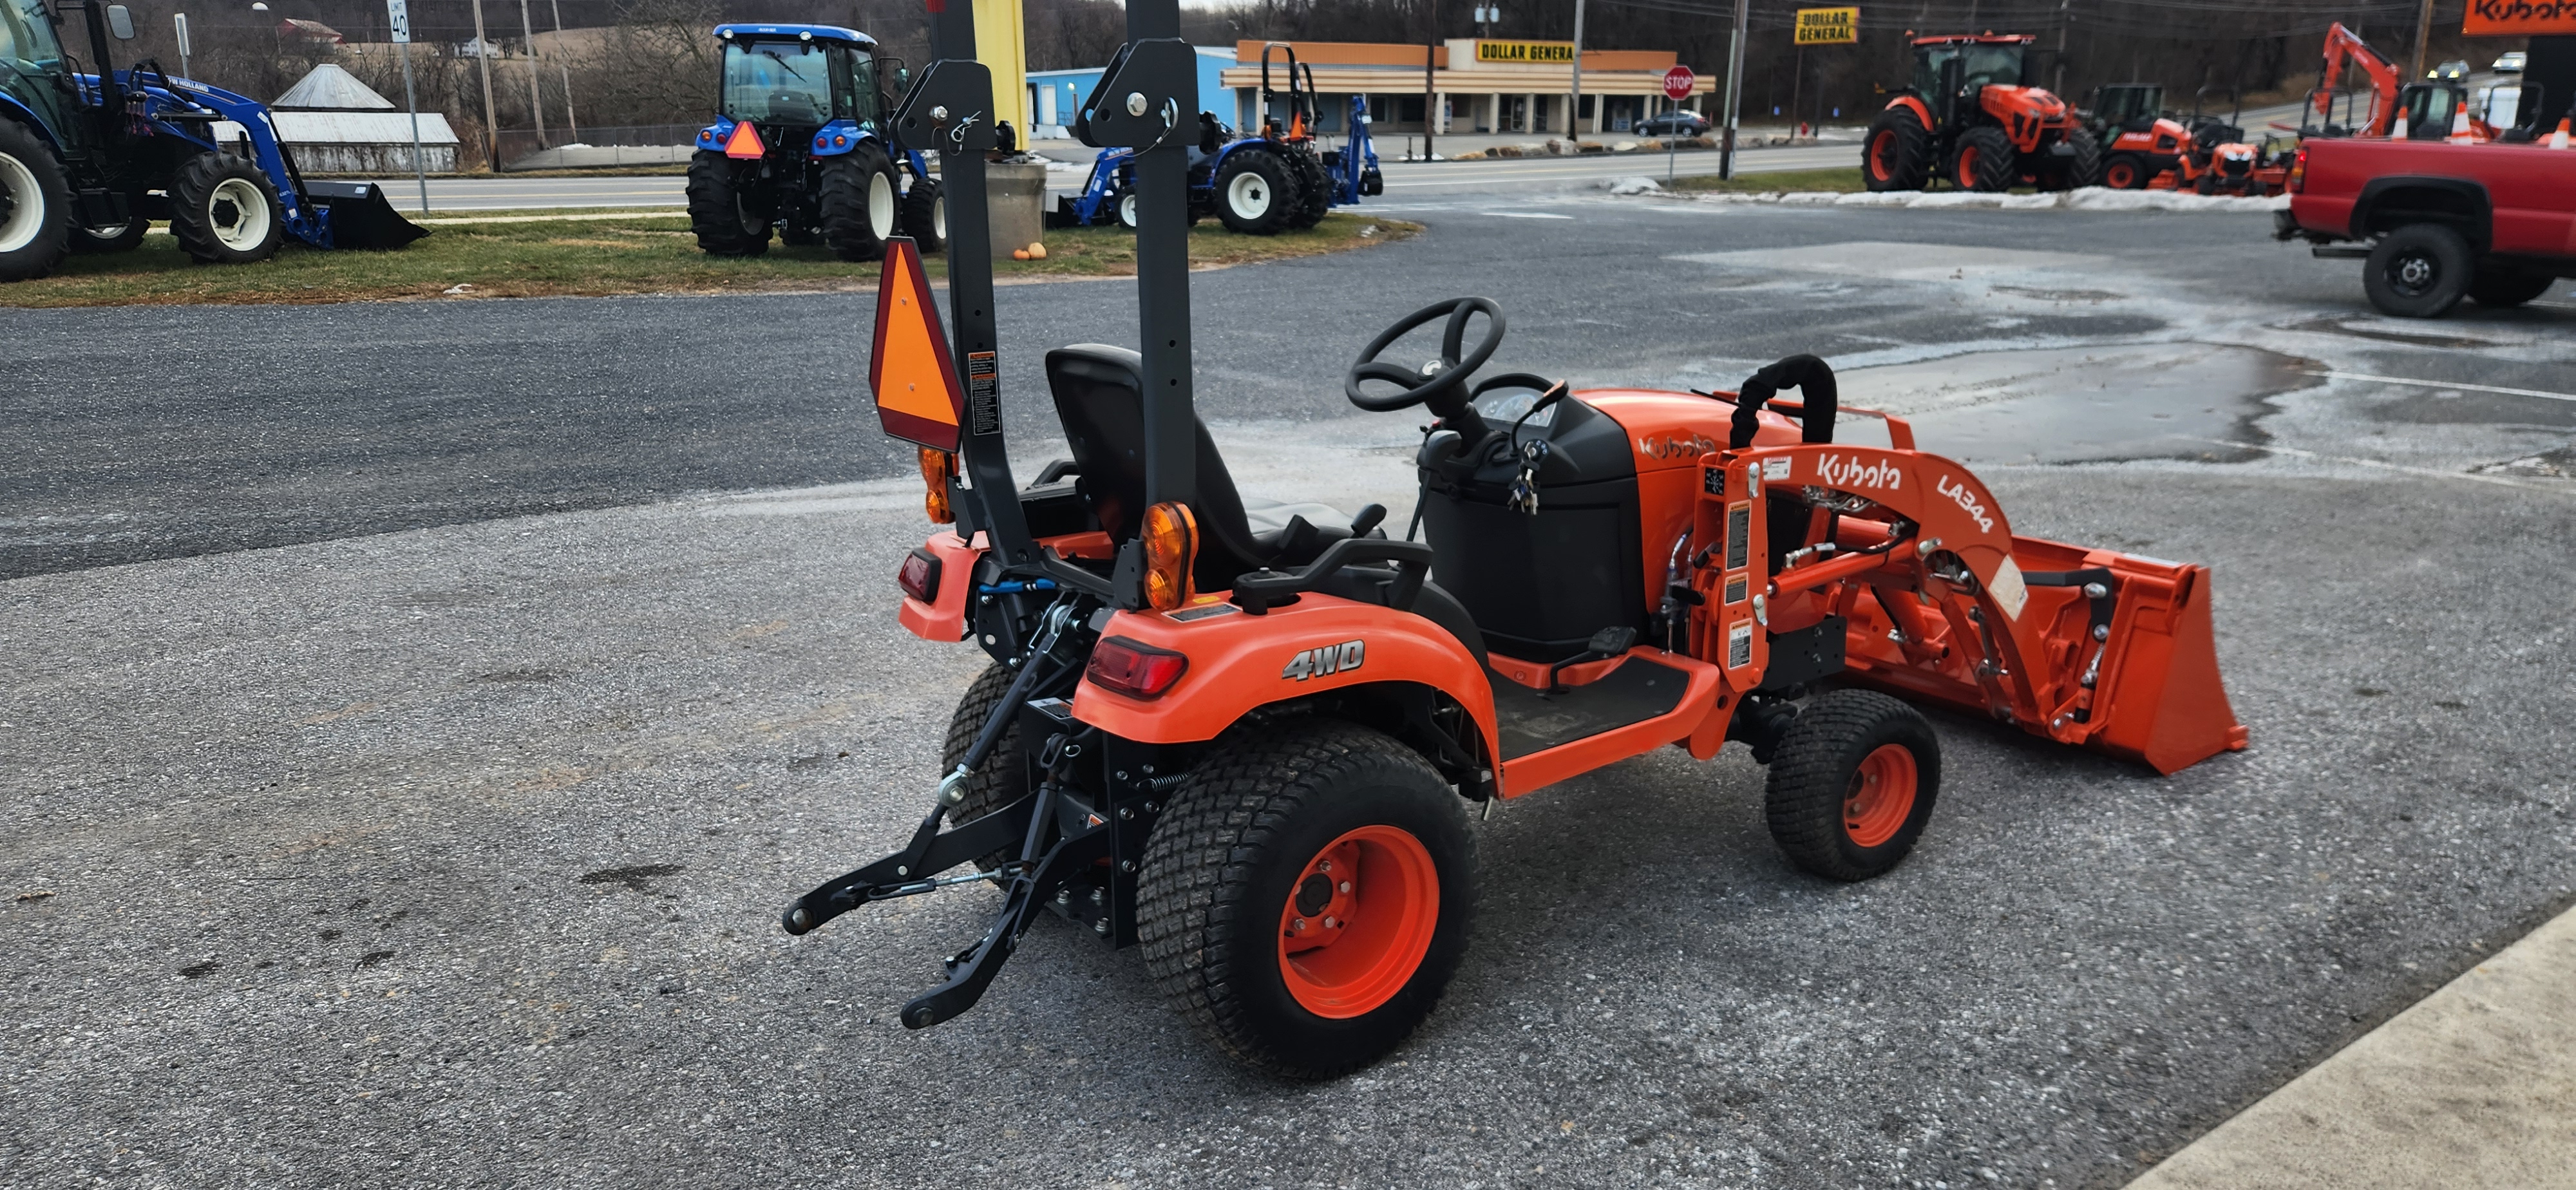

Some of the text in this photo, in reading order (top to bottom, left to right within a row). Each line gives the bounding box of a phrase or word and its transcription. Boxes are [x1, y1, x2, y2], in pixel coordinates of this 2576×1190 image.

[393, 14, 406, 36] 40
[1804, 12, 1848, 26] DOLLAR
[1799, 26, 1850, 41] GENERAL
[1482, 44, 1574, 61] DOLLAR GENERA
[180, 79, 209, 93] HOLLAND
[1665, 75, 1692, 90] STOP
[1638, 434, 1715, 460] Kubota
[1817, 453, 1901, 489] Kubota
[1937, 474, 1994, 534] LA344
[1282, 639, 1365, 682] 4WD
